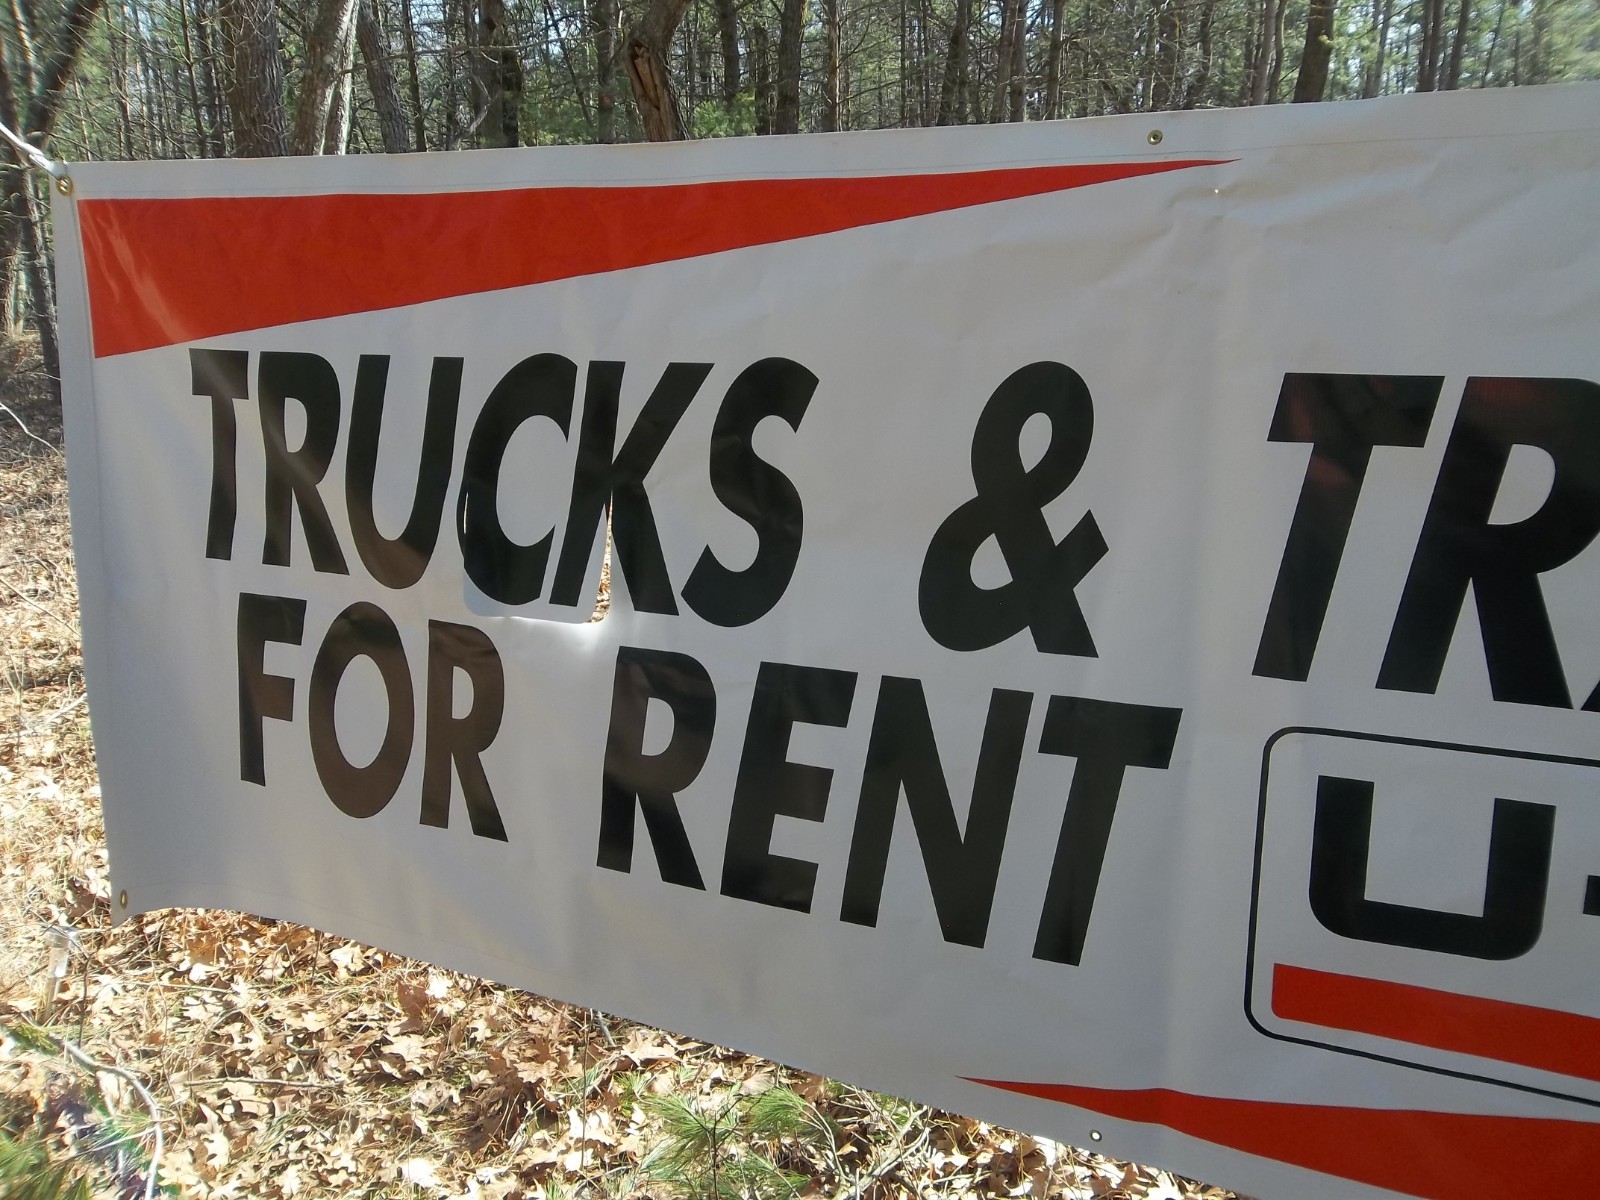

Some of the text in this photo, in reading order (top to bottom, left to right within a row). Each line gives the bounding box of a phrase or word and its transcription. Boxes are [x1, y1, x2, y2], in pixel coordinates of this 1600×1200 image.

[189, 347, 1600, 713] TRUCKS & TR
[237, 592, 1183, 967] FOR RENT
